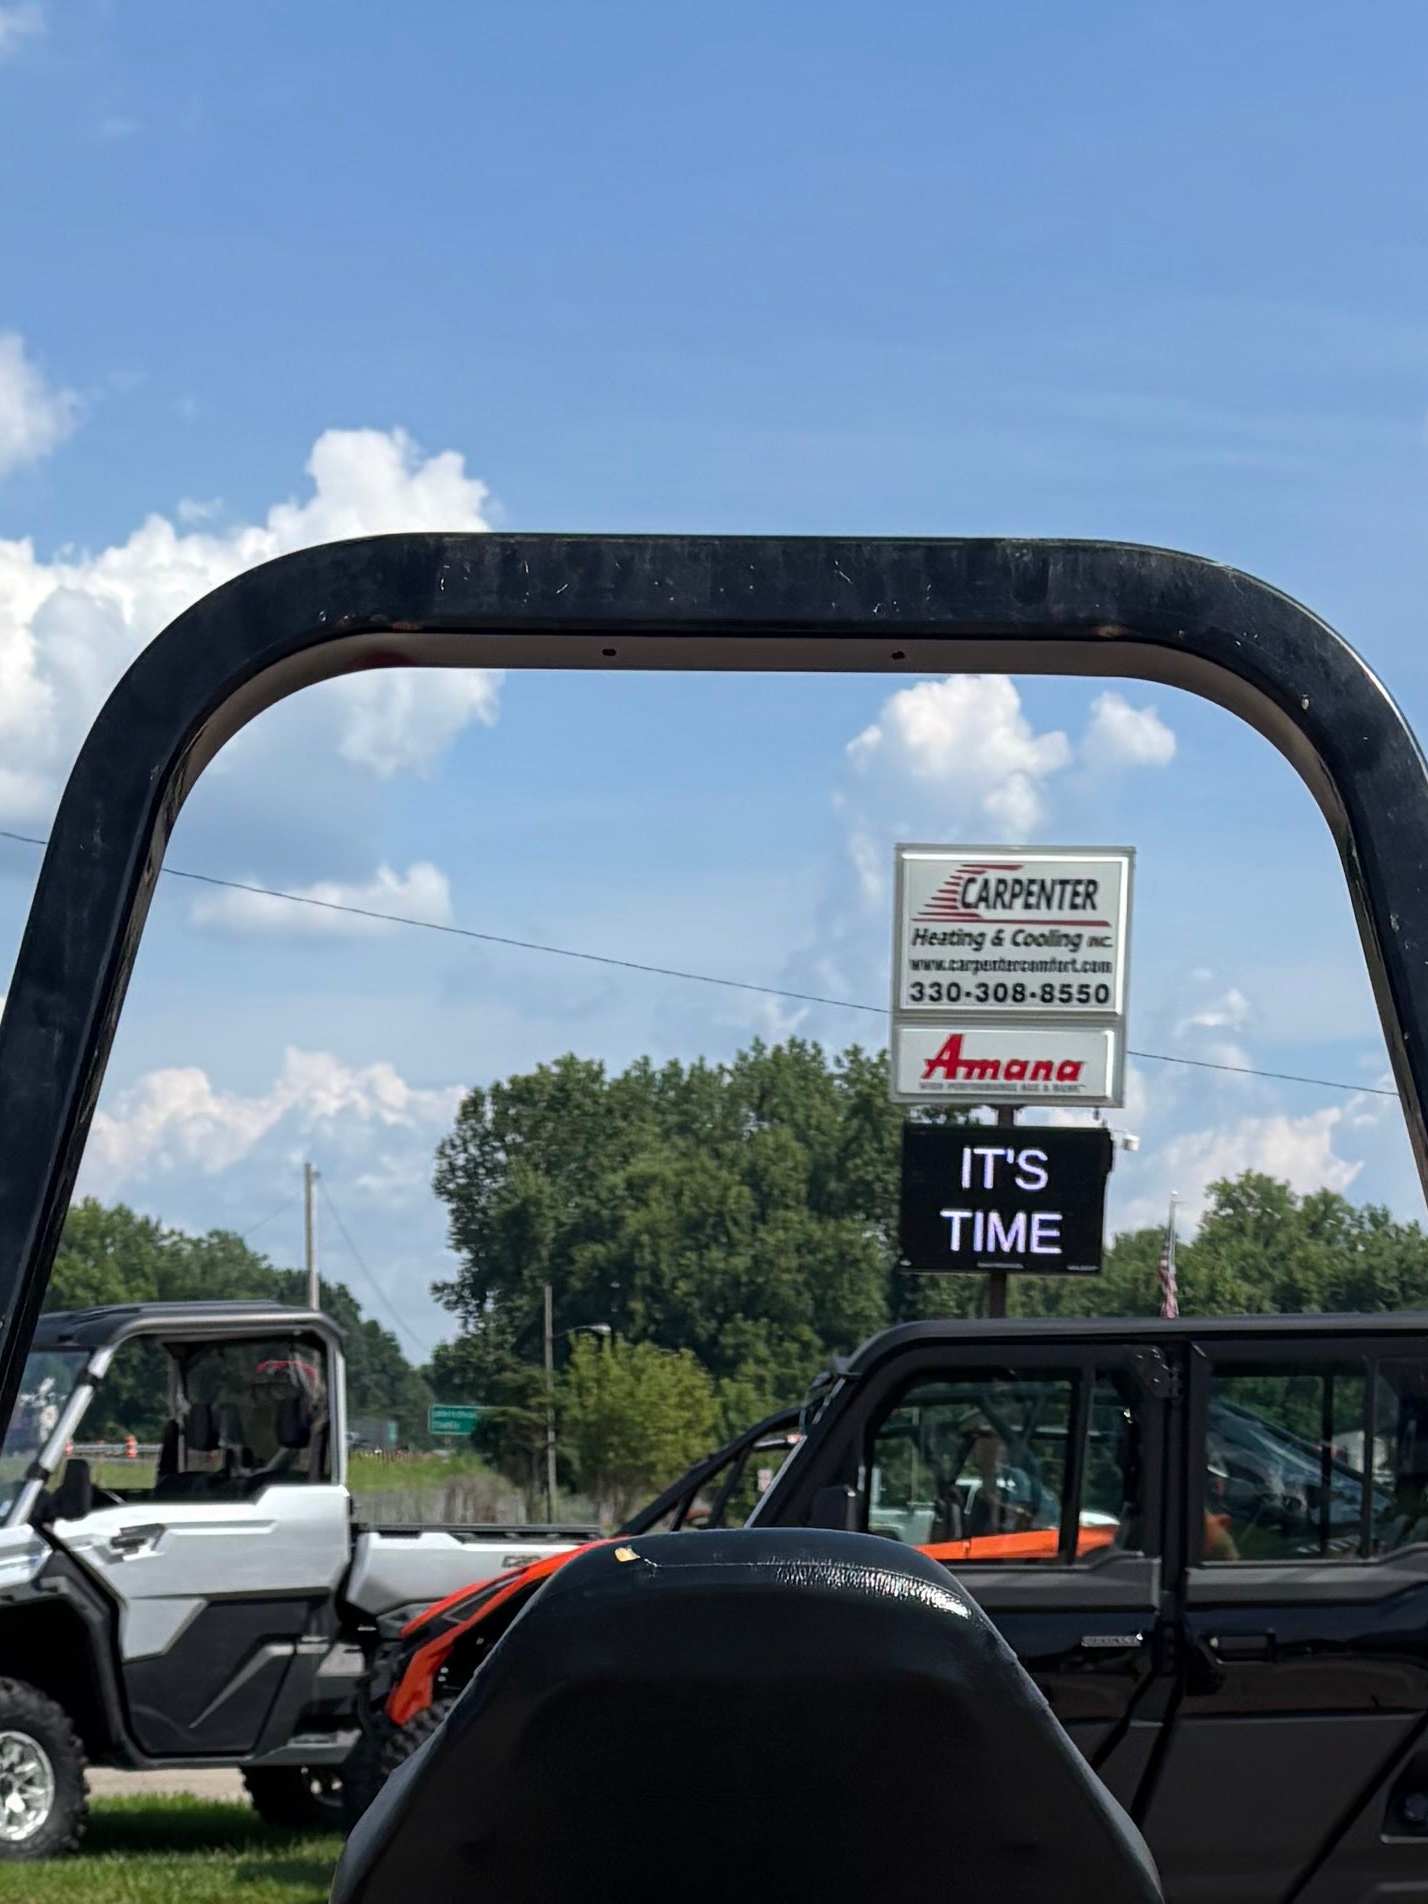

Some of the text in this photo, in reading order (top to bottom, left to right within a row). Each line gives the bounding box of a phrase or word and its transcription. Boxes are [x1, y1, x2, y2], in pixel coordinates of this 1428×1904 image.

[960, 876, 1099, 911] CARPENTER
[911, 929, 985, 951] Heating
[991, 930, 1004, 946] &
[1011, 929, 1083, 952] Cooling
[920, 1033, 1086, 1081] Amana
[961, 1147, 1049, 1190] IT'S
[939, 1209, 1063, 1254] TIME
